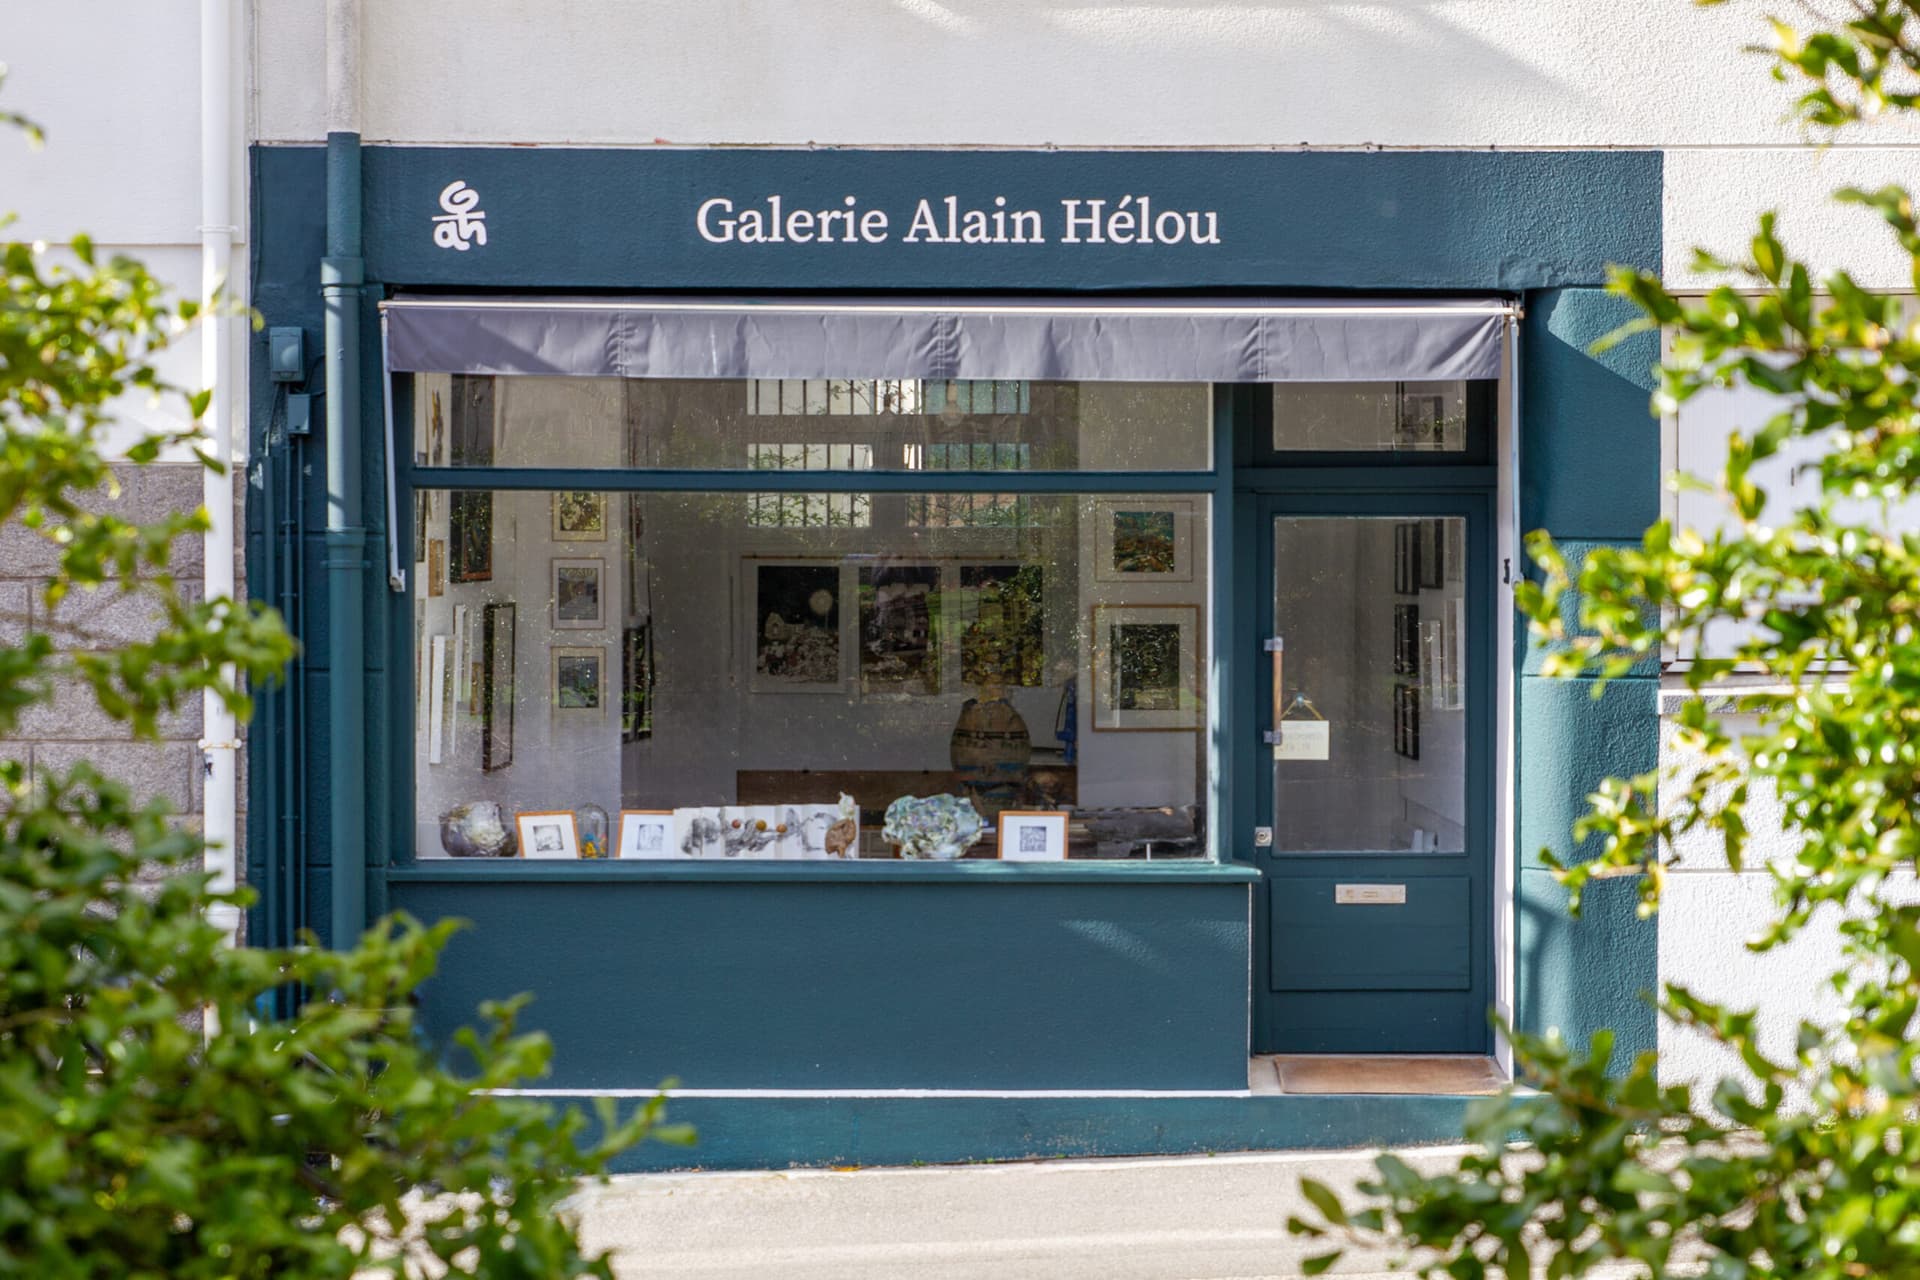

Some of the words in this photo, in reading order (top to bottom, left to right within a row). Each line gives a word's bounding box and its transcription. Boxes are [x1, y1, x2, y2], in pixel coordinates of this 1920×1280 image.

[696, 195, 888, 244] Galerie
[902, 195, 1045, 244] Alain
[1060, 194, 1221, 245] Hélou
